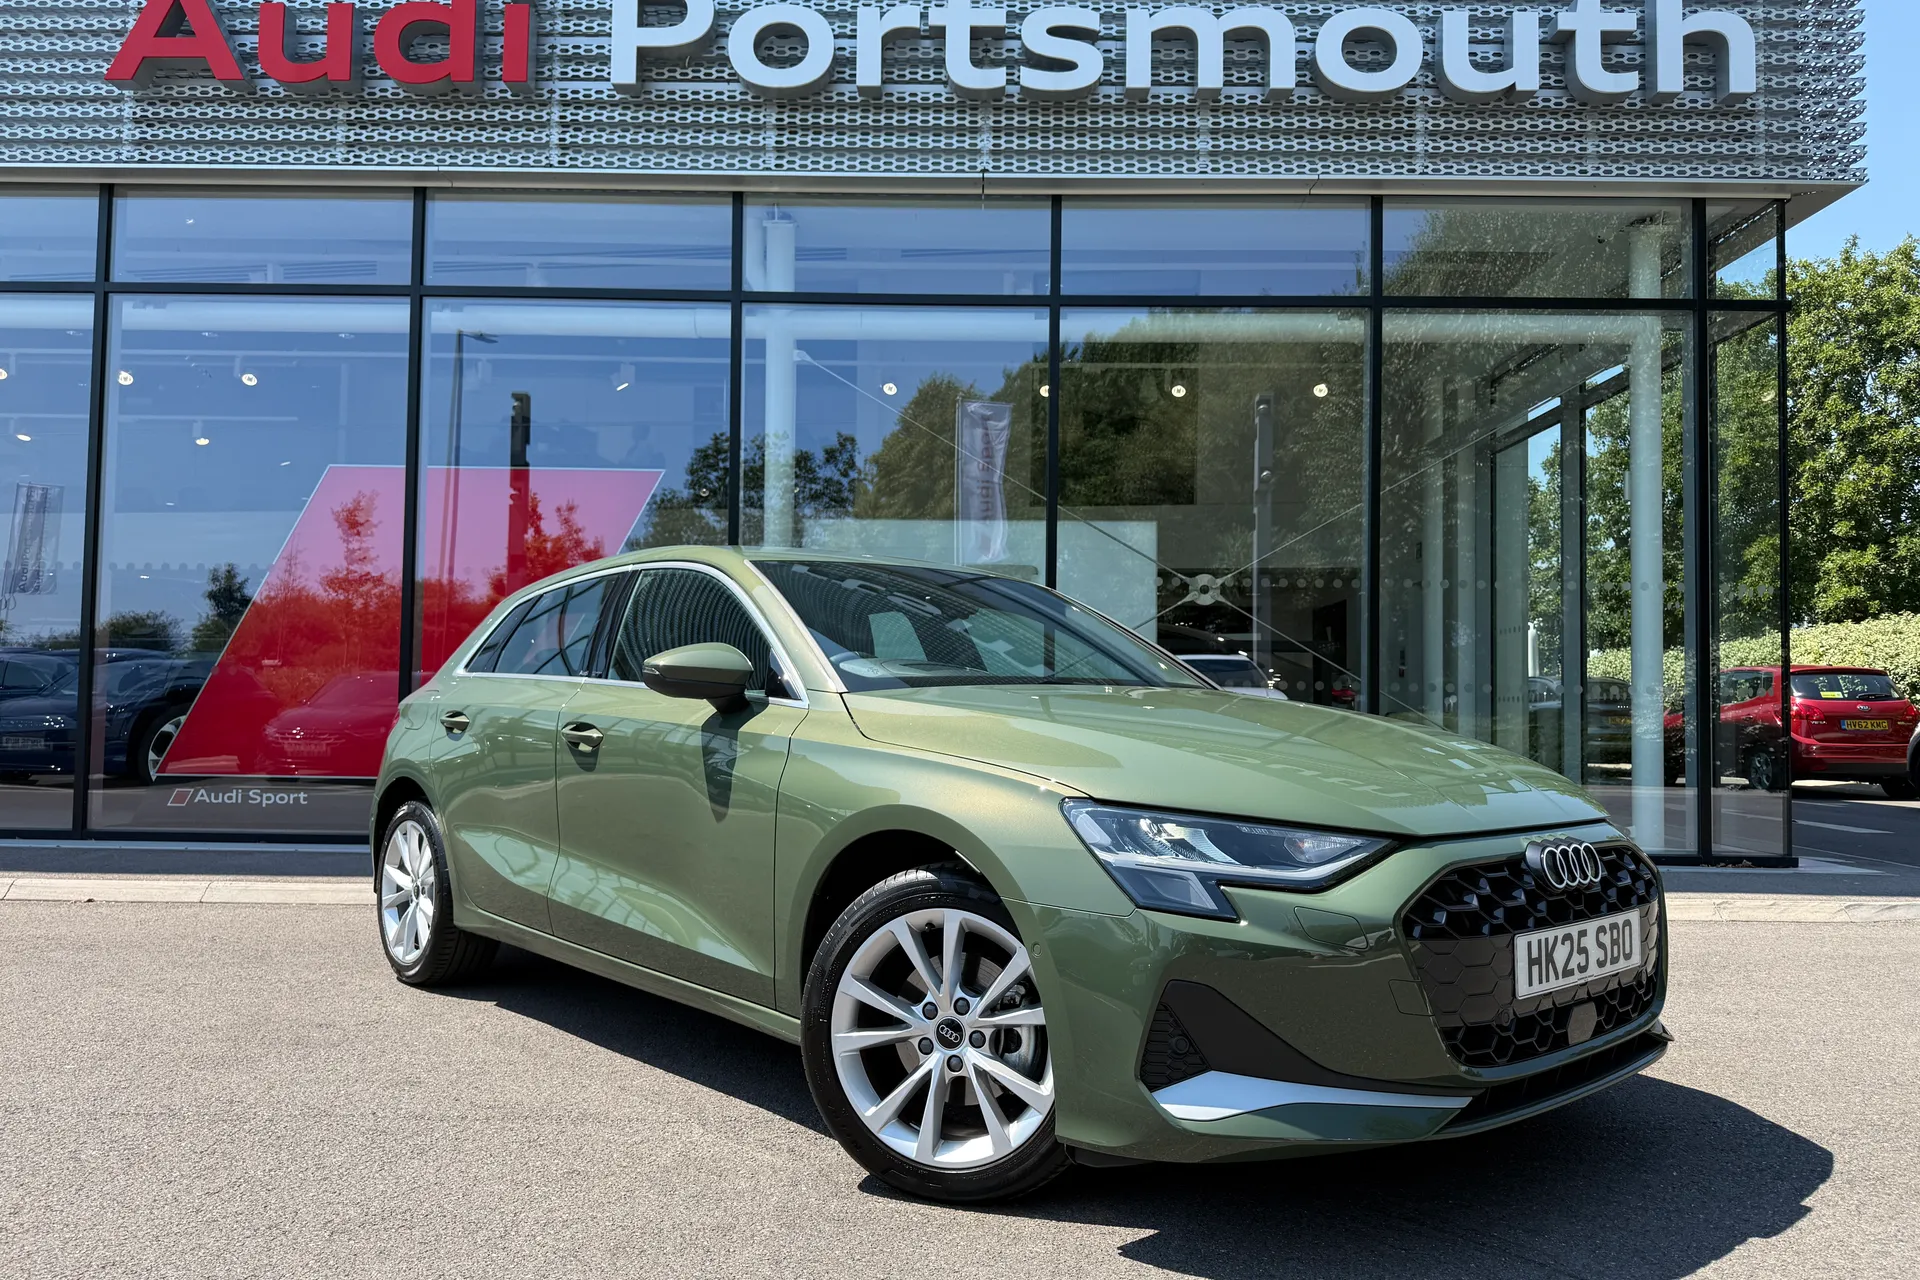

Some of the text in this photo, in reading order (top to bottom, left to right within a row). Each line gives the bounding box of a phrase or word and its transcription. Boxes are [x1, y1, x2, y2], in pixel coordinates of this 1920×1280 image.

[104, 0, 1757, 94] Audi Portsmouth
[1846, 720, 1869, 729] HV62
[194, 789, 308, 808] Audi Sport
[1527, 918, 1633, 988] HK25 SBO
